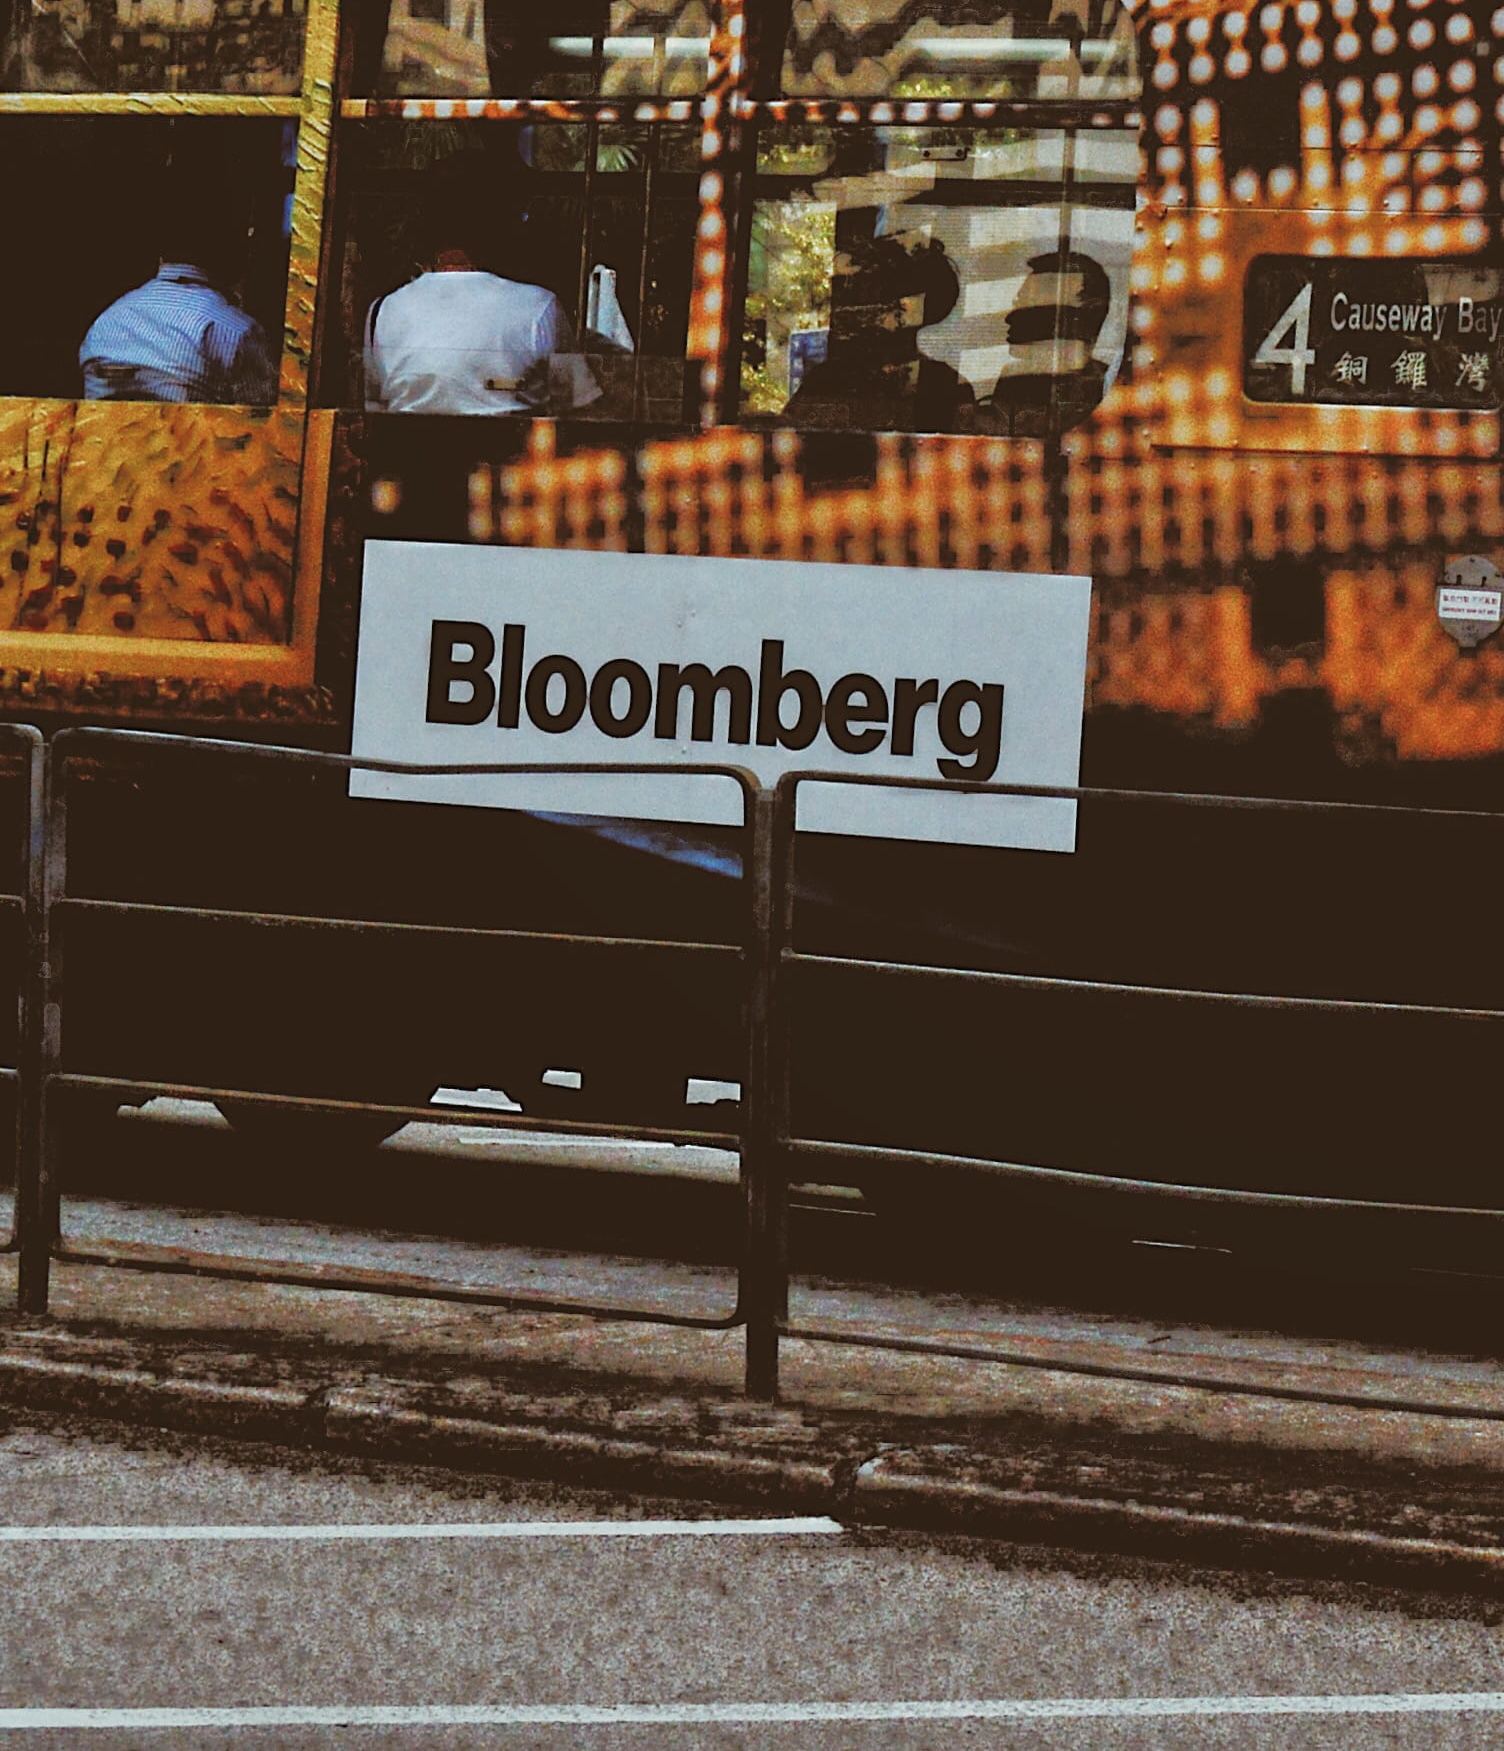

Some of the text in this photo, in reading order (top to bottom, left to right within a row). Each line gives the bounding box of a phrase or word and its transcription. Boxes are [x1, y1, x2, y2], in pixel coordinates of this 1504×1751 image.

[1253, 282, 1316, 395] 4
[1330, 292, 1503, 343] Causeway Bay
[1329, 350, 1490, 392] 銅鑼灣
[425, 619, 1005, 783] Bloomberg
